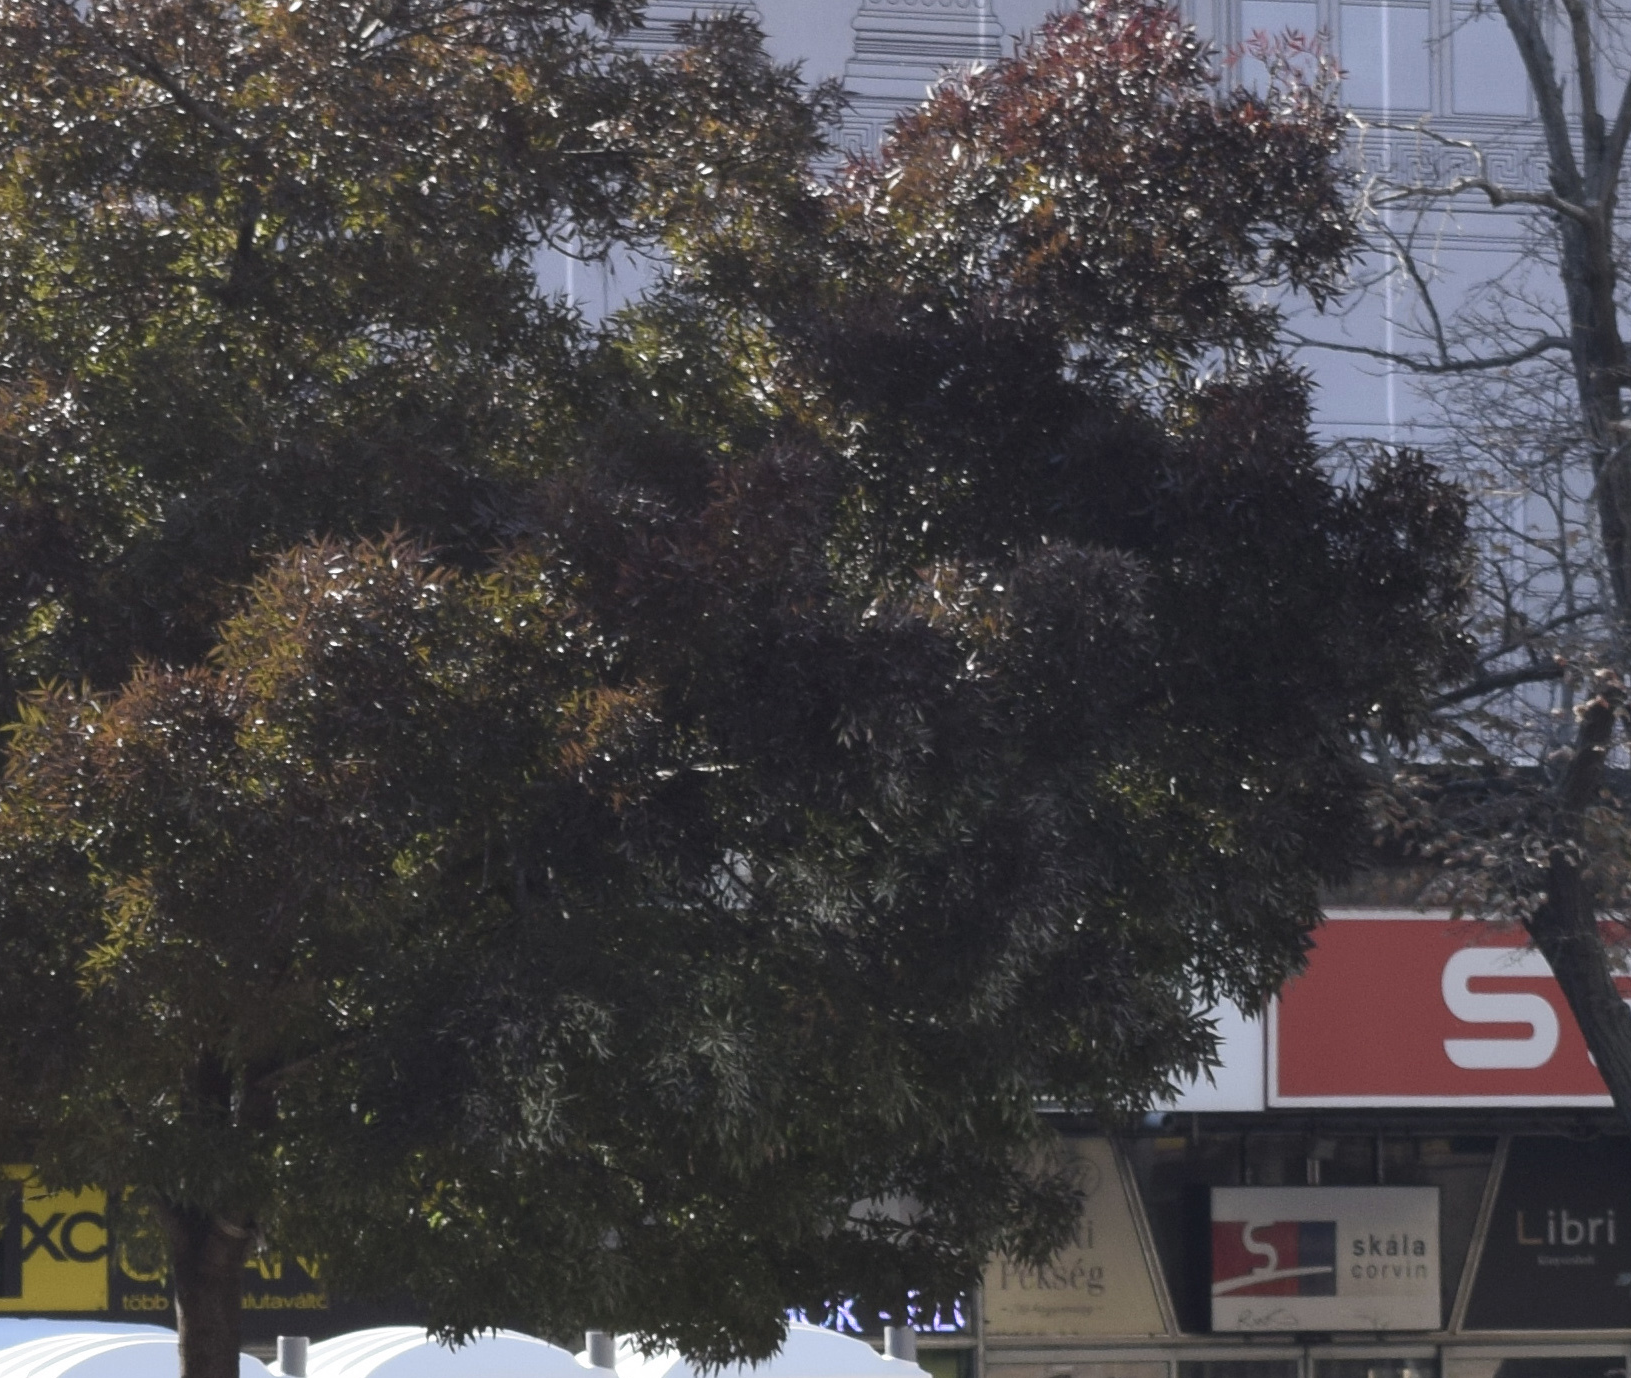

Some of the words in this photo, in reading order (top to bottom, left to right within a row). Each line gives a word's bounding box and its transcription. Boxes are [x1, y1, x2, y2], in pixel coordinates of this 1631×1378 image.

[1517, 1209, 1616, 1246] Libri
[1353, 1233, 1426, 1257] skála
[1351, 1260, 1428, 1280] corvin
